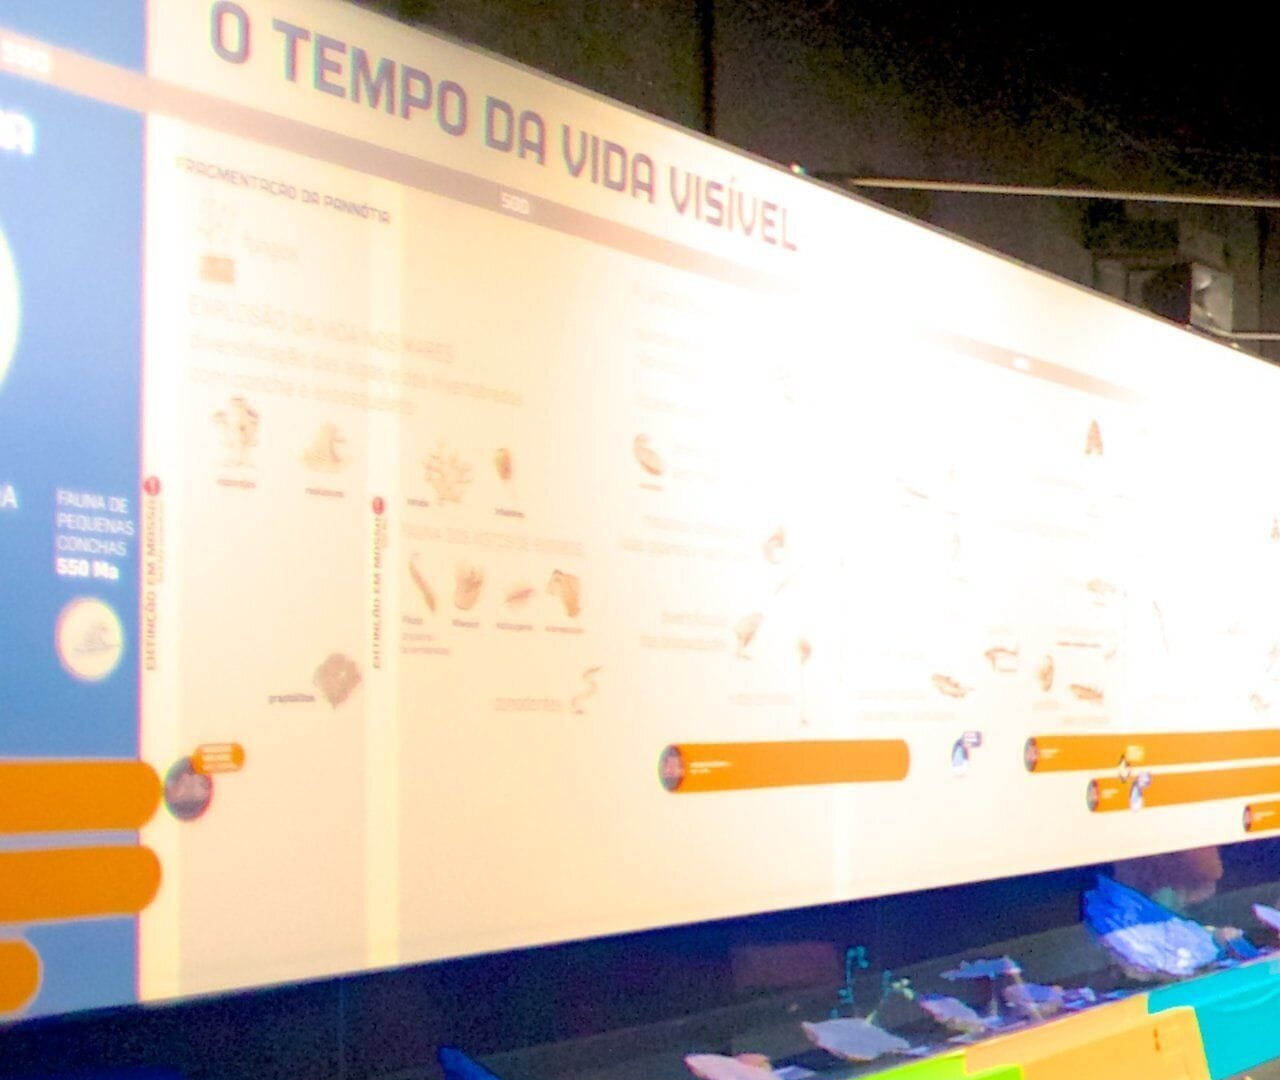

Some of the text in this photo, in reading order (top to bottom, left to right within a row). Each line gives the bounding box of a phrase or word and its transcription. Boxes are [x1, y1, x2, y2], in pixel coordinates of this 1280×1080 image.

[210, 0, 797, 252] O TEMPO DA VIDA VISÍVEL
[301, 188, 320, 205] DA
[56, 488, 129, 514] FAUNA DE
[56, 512, 135, 536] PEQUENAS
[56, 534, 128, 556] CONCHAS
[56, 557, 89, 578] 550
